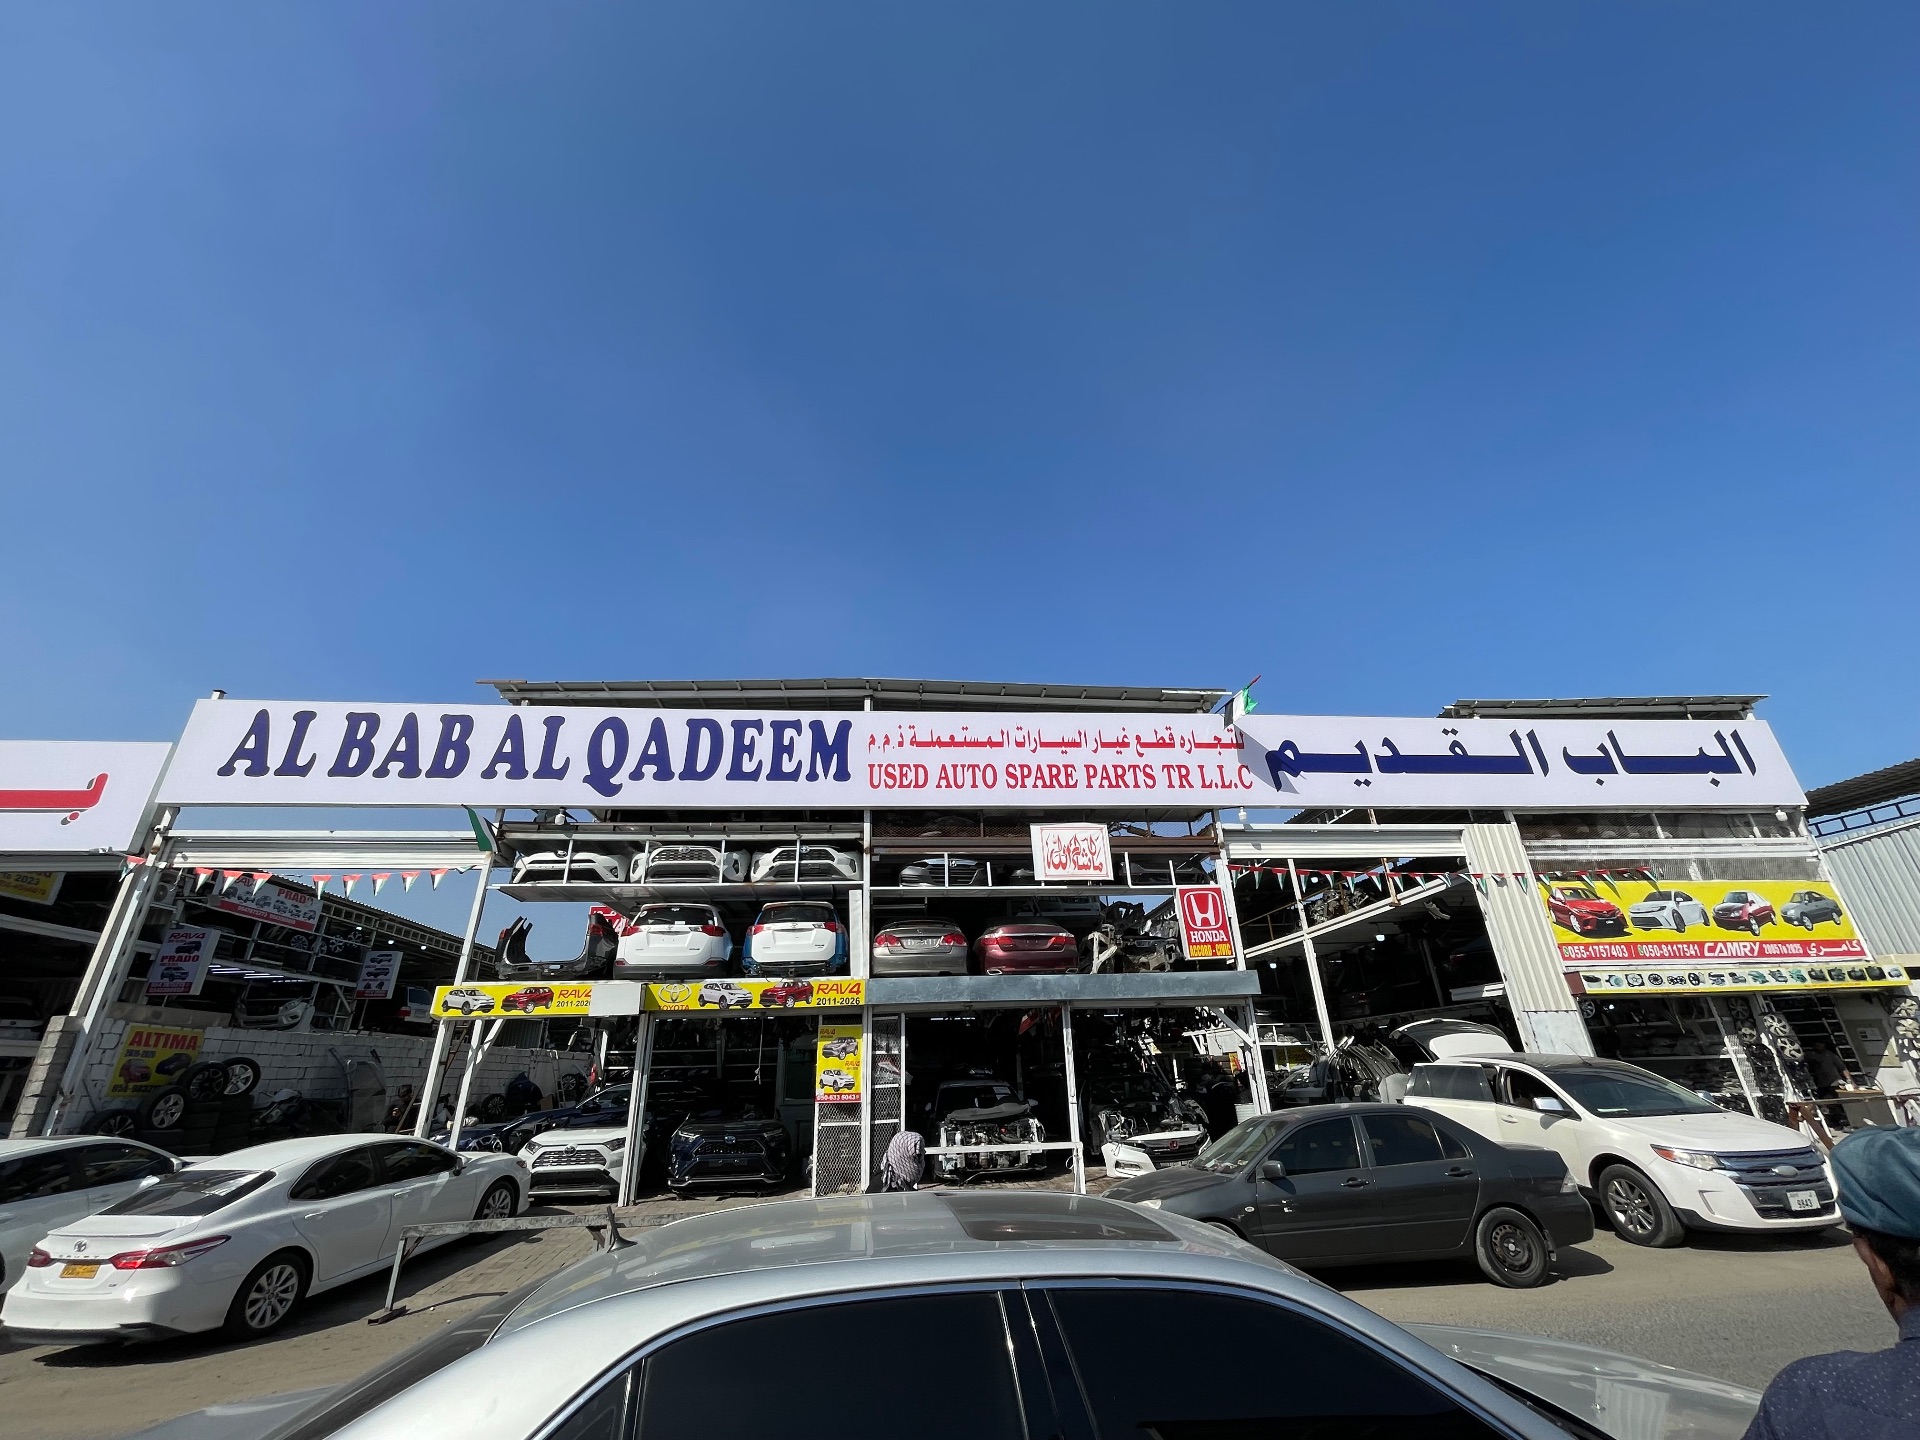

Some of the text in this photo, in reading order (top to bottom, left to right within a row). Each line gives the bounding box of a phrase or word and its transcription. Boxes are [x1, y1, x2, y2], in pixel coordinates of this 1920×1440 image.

[908, 724, 1010, 750] المستعملة
[1014, 724, 1088, 755] السيارات
[1091, 726, 1131, 755] غيار
[1134, 725, 1176, 758] قطع
[216, 708, 853, 798] AL BAB AL QADEEM
[1264, 727, 1758, 793] الباب القديم
[867, 763, 1254, 790] USED AUTO SPARE PARTS TR L.L.C
[169, 932, 207, 940] RAV4
[1189, 929, 1228, 943] HONDA
[159, 954, 200, 963] PRADO
[1703, 941, 1760, 957] CAMRY
[558, 988, 592, 999] RAV4
[816, 982, 862, 996] RAV4
[816, 996, 861, 1006] 2011-2026
[128, 1030, 199, 1051] ALTIMA
